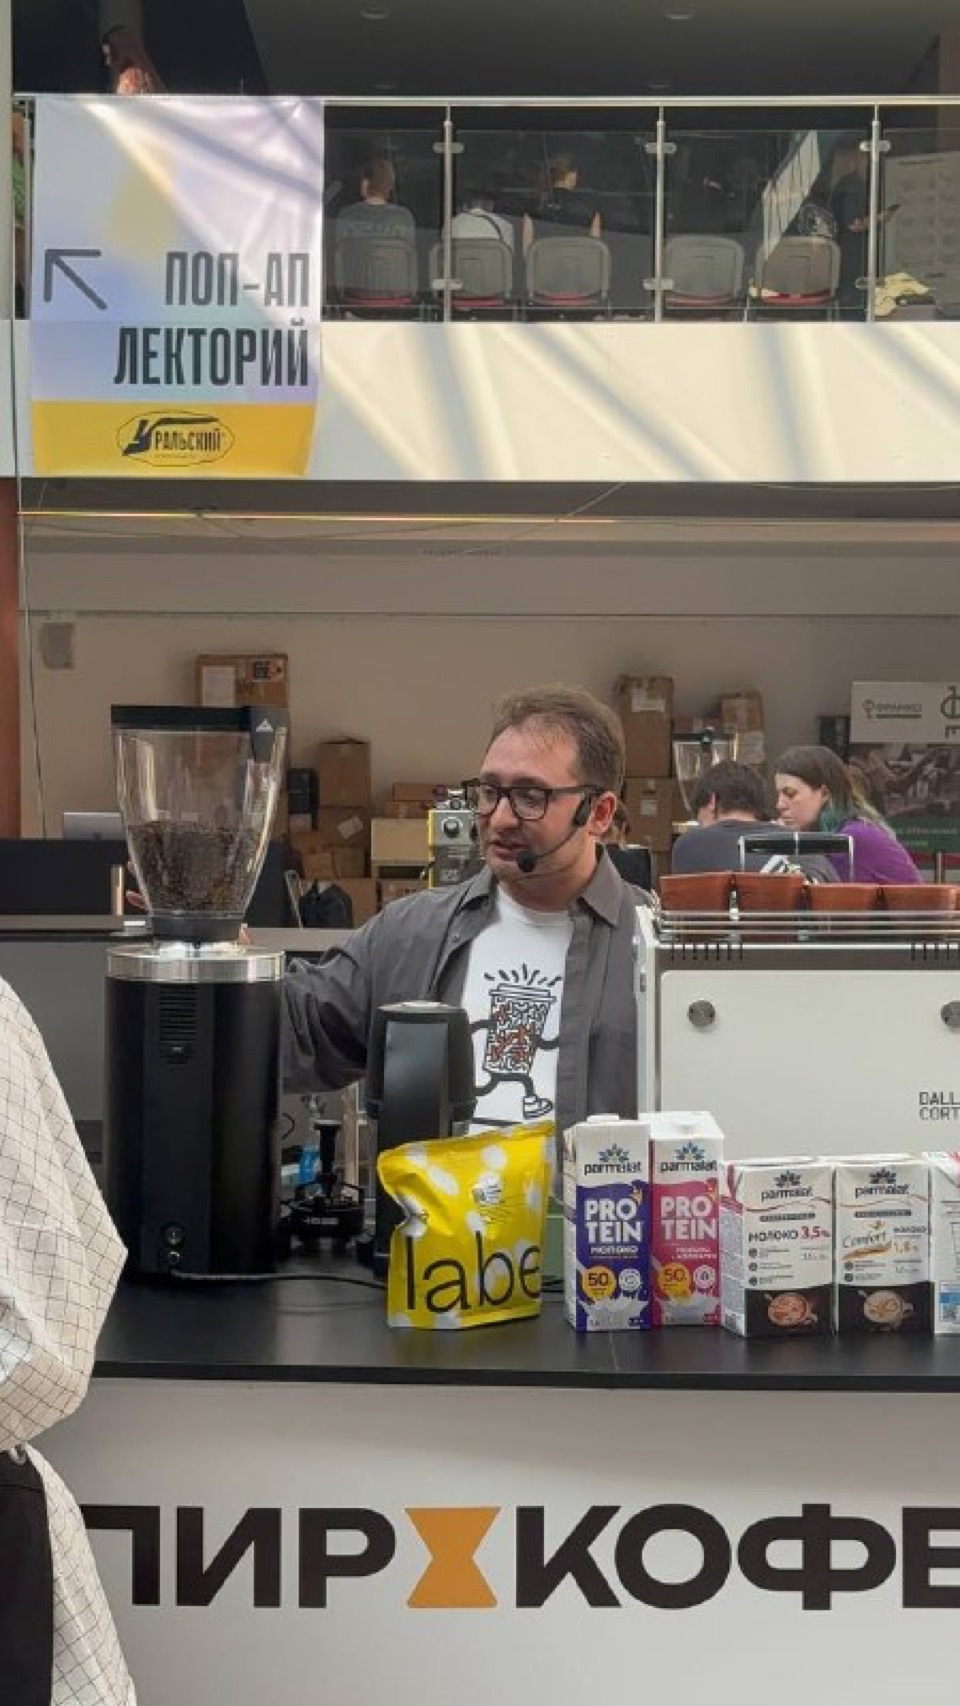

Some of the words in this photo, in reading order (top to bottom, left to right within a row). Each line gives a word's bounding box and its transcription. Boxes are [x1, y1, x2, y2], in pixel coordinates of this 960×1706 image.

[165, 250, 311, 307] ПОП-АП
[113, 317, 309, 386] ЛЕКТОРИЙ
[584, 1161, 641, 1175] parmalat
[660, 1159, 717, 1173] parmalat
[761, 1186, 813, 1202] parmalat
[855, 1184, 909, 1199] parmalat
[584, 1197, 637, 1221] PRO
[660, 1195, 712, 1218] PRO
[585, 1221, 642, 1242] TEIN
[660, 1219, 717, 1240] TEIN
[80, 1505, 397, 1608] ПИР
[516, 1503, 960, 1611] КОФЕ
